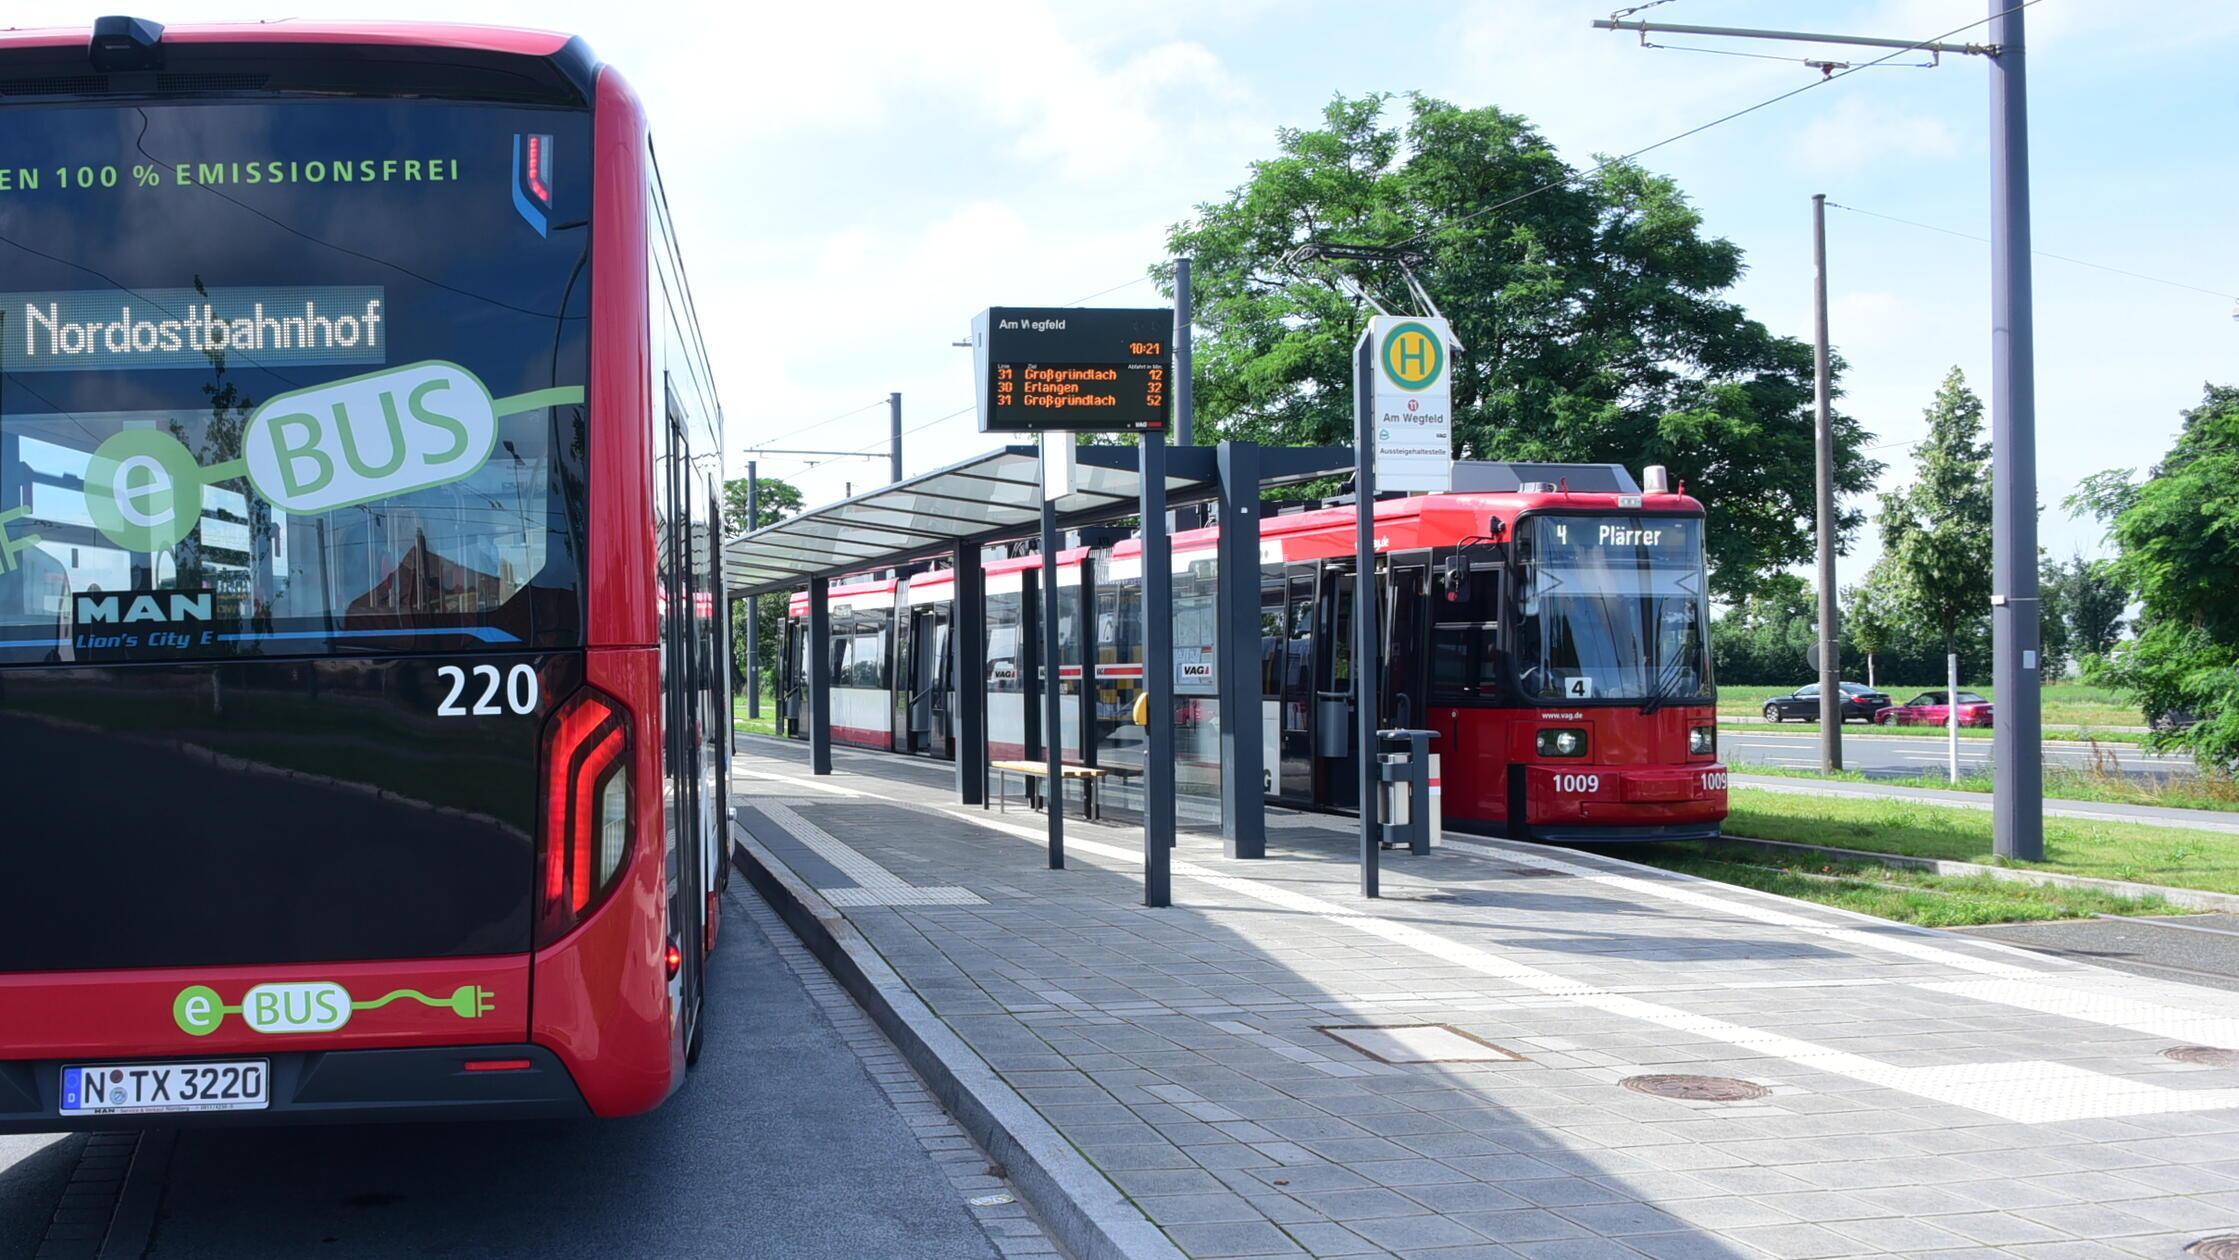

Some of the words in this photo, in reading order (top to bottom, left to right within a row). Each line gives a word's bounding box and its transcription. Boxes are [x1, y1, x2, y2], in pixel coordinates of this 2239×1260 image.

[56, 166, 118, 189] 100
[132, 164, 161, 187] %
[176, 158, 459, 186] EMISSIONSFREI
[26, 298, 381, 355] Nordostbahnhof
[999, 319, 1019, 330] Am
[1129, 342, 1160, 355] 10:21
[1400, 337, 1425, 375] H
[998, 369, 1013, 380] 31
[1024, 368, 1117, 382] Großgründlach
[1149, 369, 1163, 380] 12
[998, 382, 1013, 393] 30
[1024, 382, 1079, 395] Erlangen
[1147, 382, 1162, 393] 32
[997, 395, 1012, 406] 31
[1023, 395, 1116, 408] Großgründlach
[1146, 395, 1162, 406] 52
[1383, 413, 1400, 423] Am
[1402, 413, 1444, 426] Wegfeld
[113, 455, 176, 527] e
[267, 378, 470, 499] BUS
[1380, 448, 1447, 456] Aussteigehaltestelle
[1557, 525, 1567, 544] 4
[1599, 524, 1662, 546] Plärrer
[78, 594, 212, 625] MAN
[149, 631, 191, 649] City
[200, 631, 214, 645] E
[1184, 665, 1204, 675] VAG
[436, 663, 540, 717] 220
[1571, 680, 1585, 696] 4
[1542, 711, 1584, 720] www.vag.de
[1553, 774, 1599, 792] 1009
[1701, 773, 1727, 791] 1009
[186, 993, 211, 1026] e
[255, 988, 339, 1025] BUS
[84, 1072, 105, 1103] N
[129, 1070, 170, 1102] TX
[179, 1067, 261, 1101] 3220
